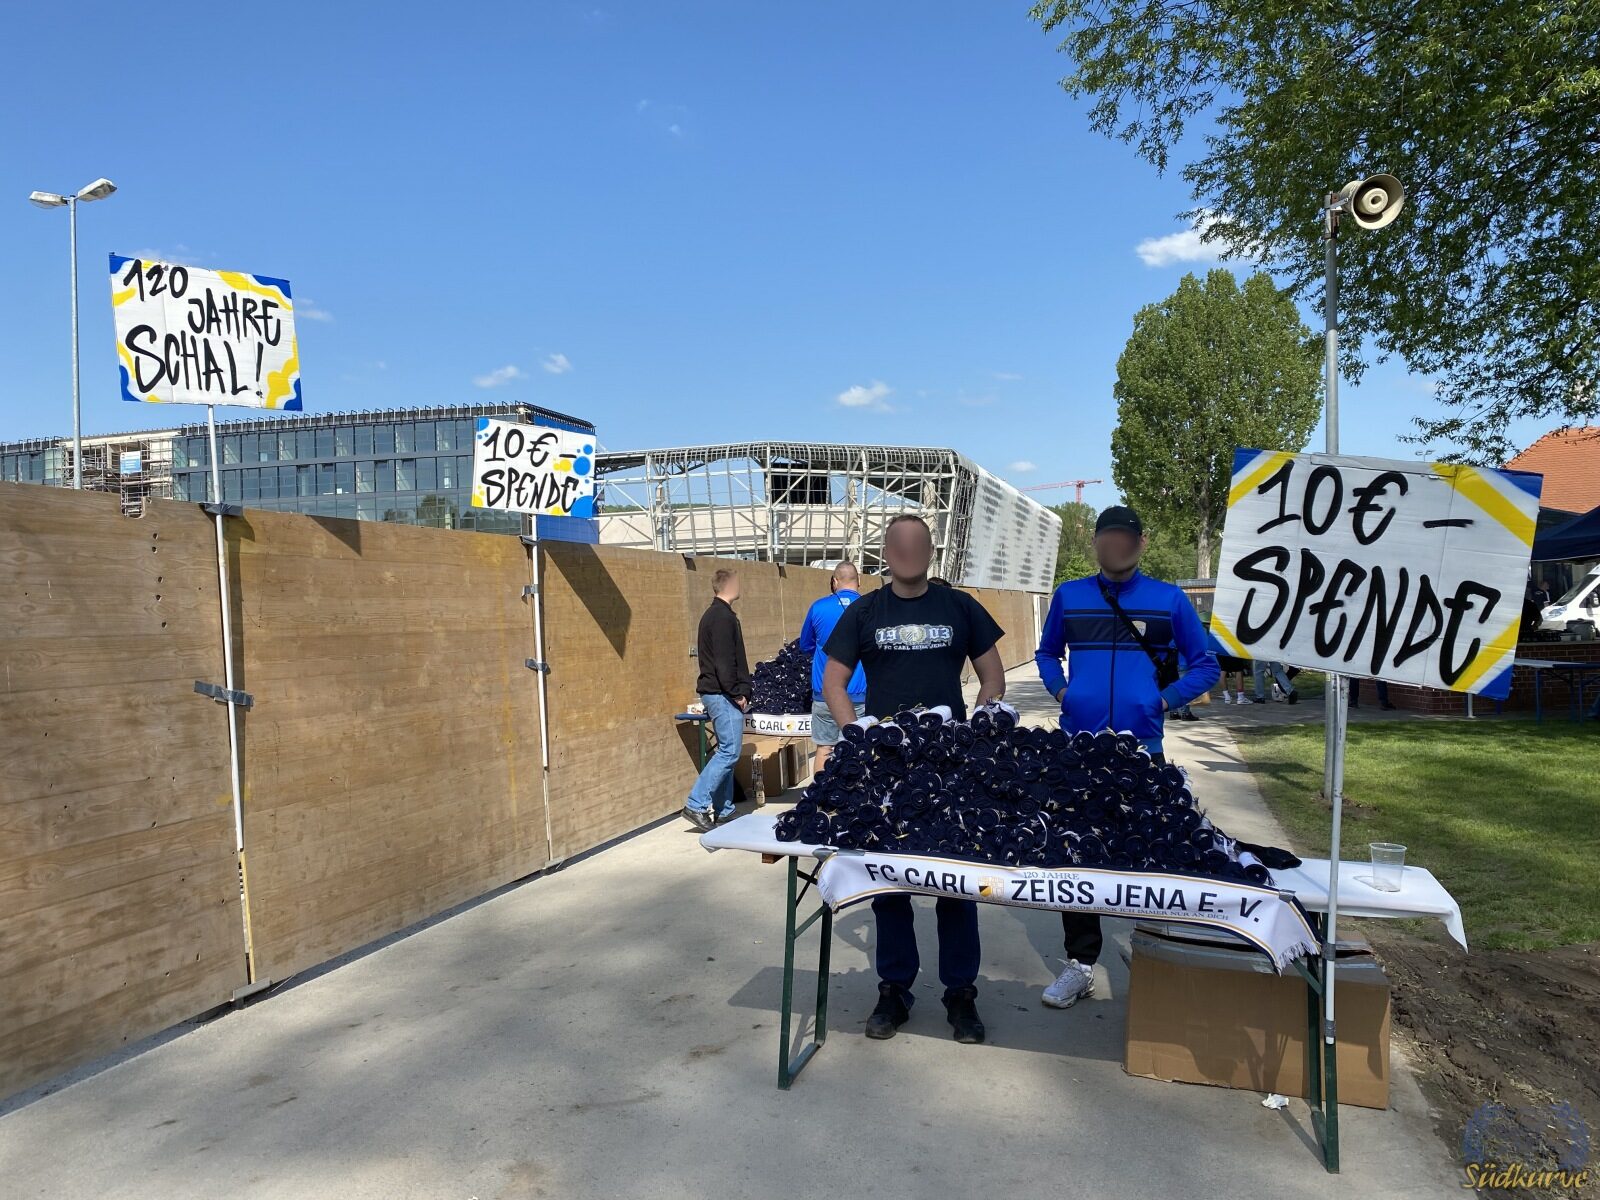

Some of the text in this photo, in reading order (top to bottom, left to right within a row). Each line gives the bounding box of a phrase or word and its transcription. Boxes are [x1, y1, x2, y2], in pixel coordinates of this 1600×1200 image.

[123, 259, 188, 301] 120
[188, 288, 281, 346] JAHRE
[125, 324, 264, 398] SCHAL!
[481, 467, 579, 513] SPENDE
[1233, 546, 1501, 686] SPENDE
[745, 718, 757, 729] FC
[759, 720, 786, 731] CARL
[865, 863, 898, 882] FC
[904, 867, 974, 896] CARL
[1011, 879, 1095, 905] ZEISS
[1104, 883, 1187, 911] JENA
[1198, 892, 1223, 913] E.
[1240, 897, 1263, 923] V.
[1023, 871, 1080, 881] 120 JAHRE
[1138, 908, 1168, 916] IMMER
[1207, 913, 1229, 921] DICH
